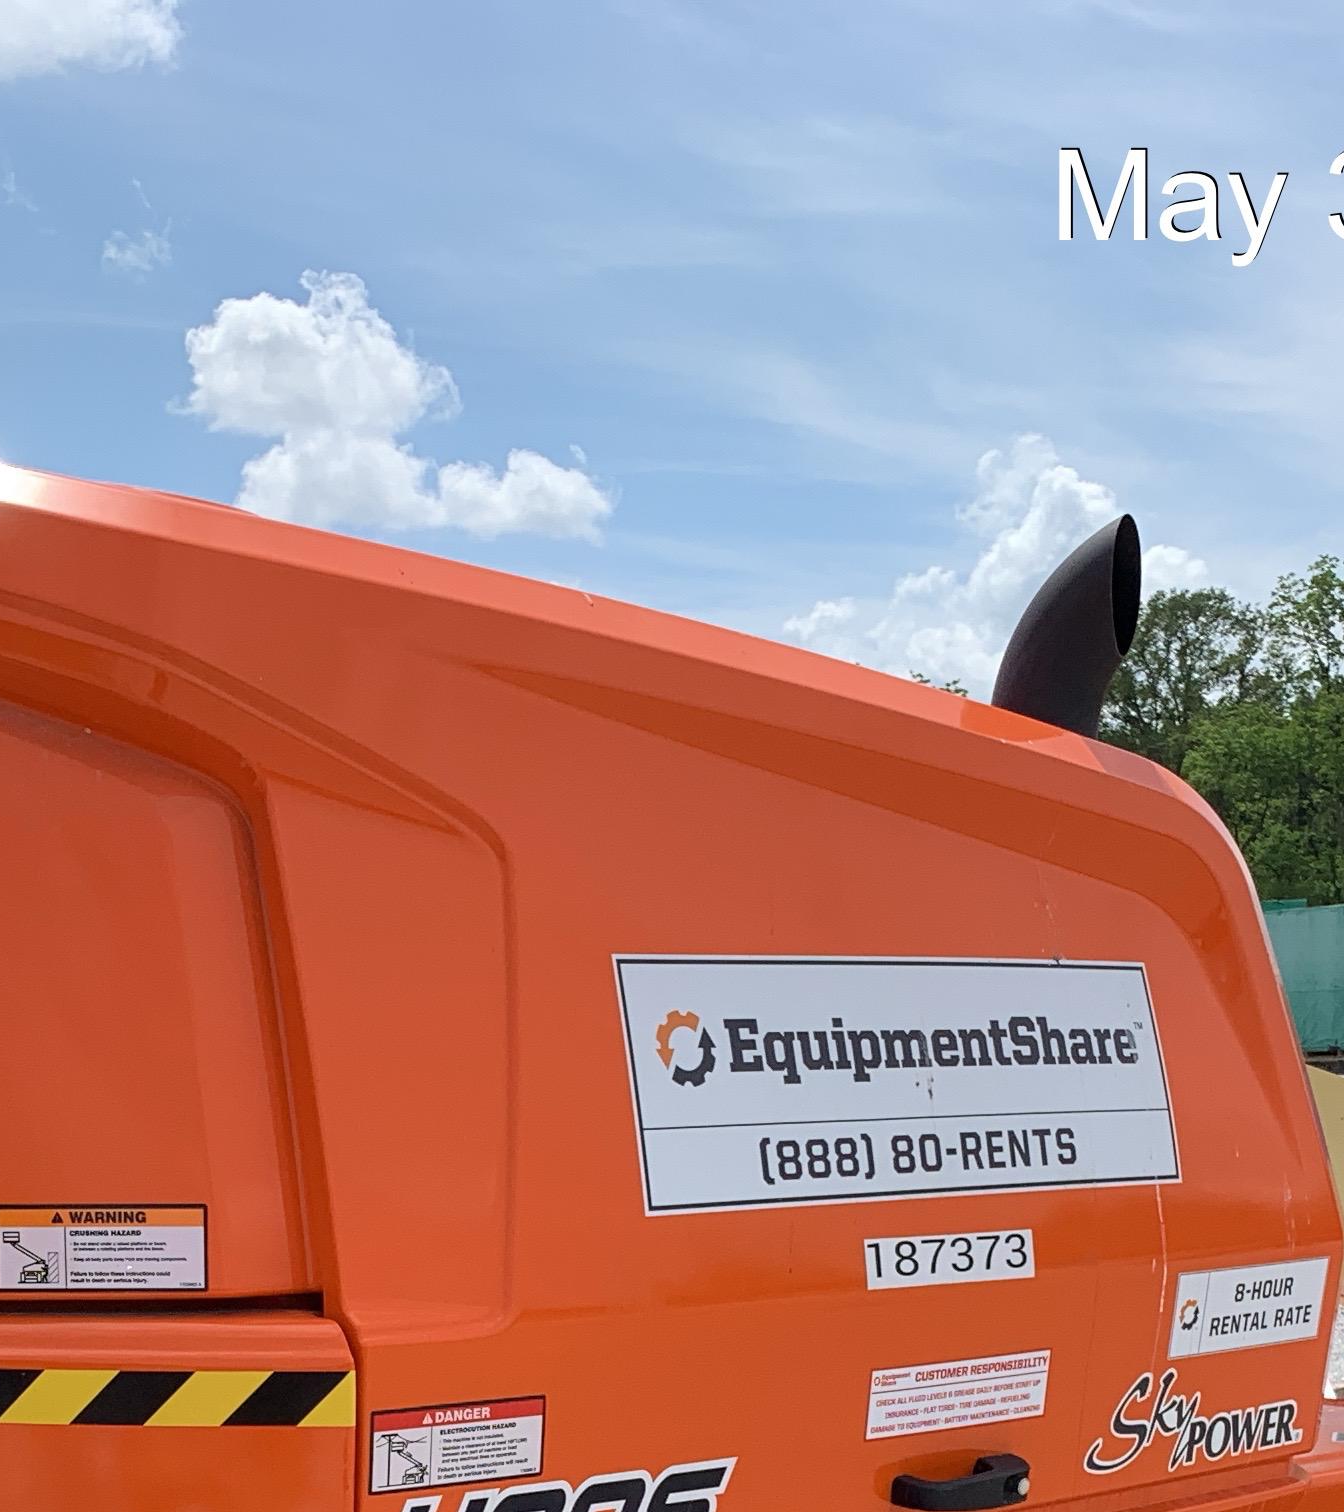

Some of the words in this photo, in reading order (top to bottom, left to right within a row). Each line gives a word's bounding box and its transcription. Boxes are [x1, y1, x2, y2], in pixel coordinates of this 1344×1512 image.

[723, 1016, 1138, 1085] EquipmentShare
[759, 1133, 876, 1185] (888)
[892, 1127, 1077, 1174] 80-RENTS
[68, 1211, 147, 1224] WARNING
[867, 1234, 1028, 1278] 187373
[1234, 1277, 1294, 1303] 8-HOUR
[1209, 1311, 1268, 1337] RENTAL
[1274, 1304, 1313, 1328] RATE
[915, 1366, 969, 1382] CUSTOMER
[970, 1356, 1049, 1375] RESPONSIBILITY
[435, 1407, 491, 1423] DANGER
[440, 1425, 491, 1435] ELECTROCUTION
[492, 1422, 517, 1430] HAZARD
